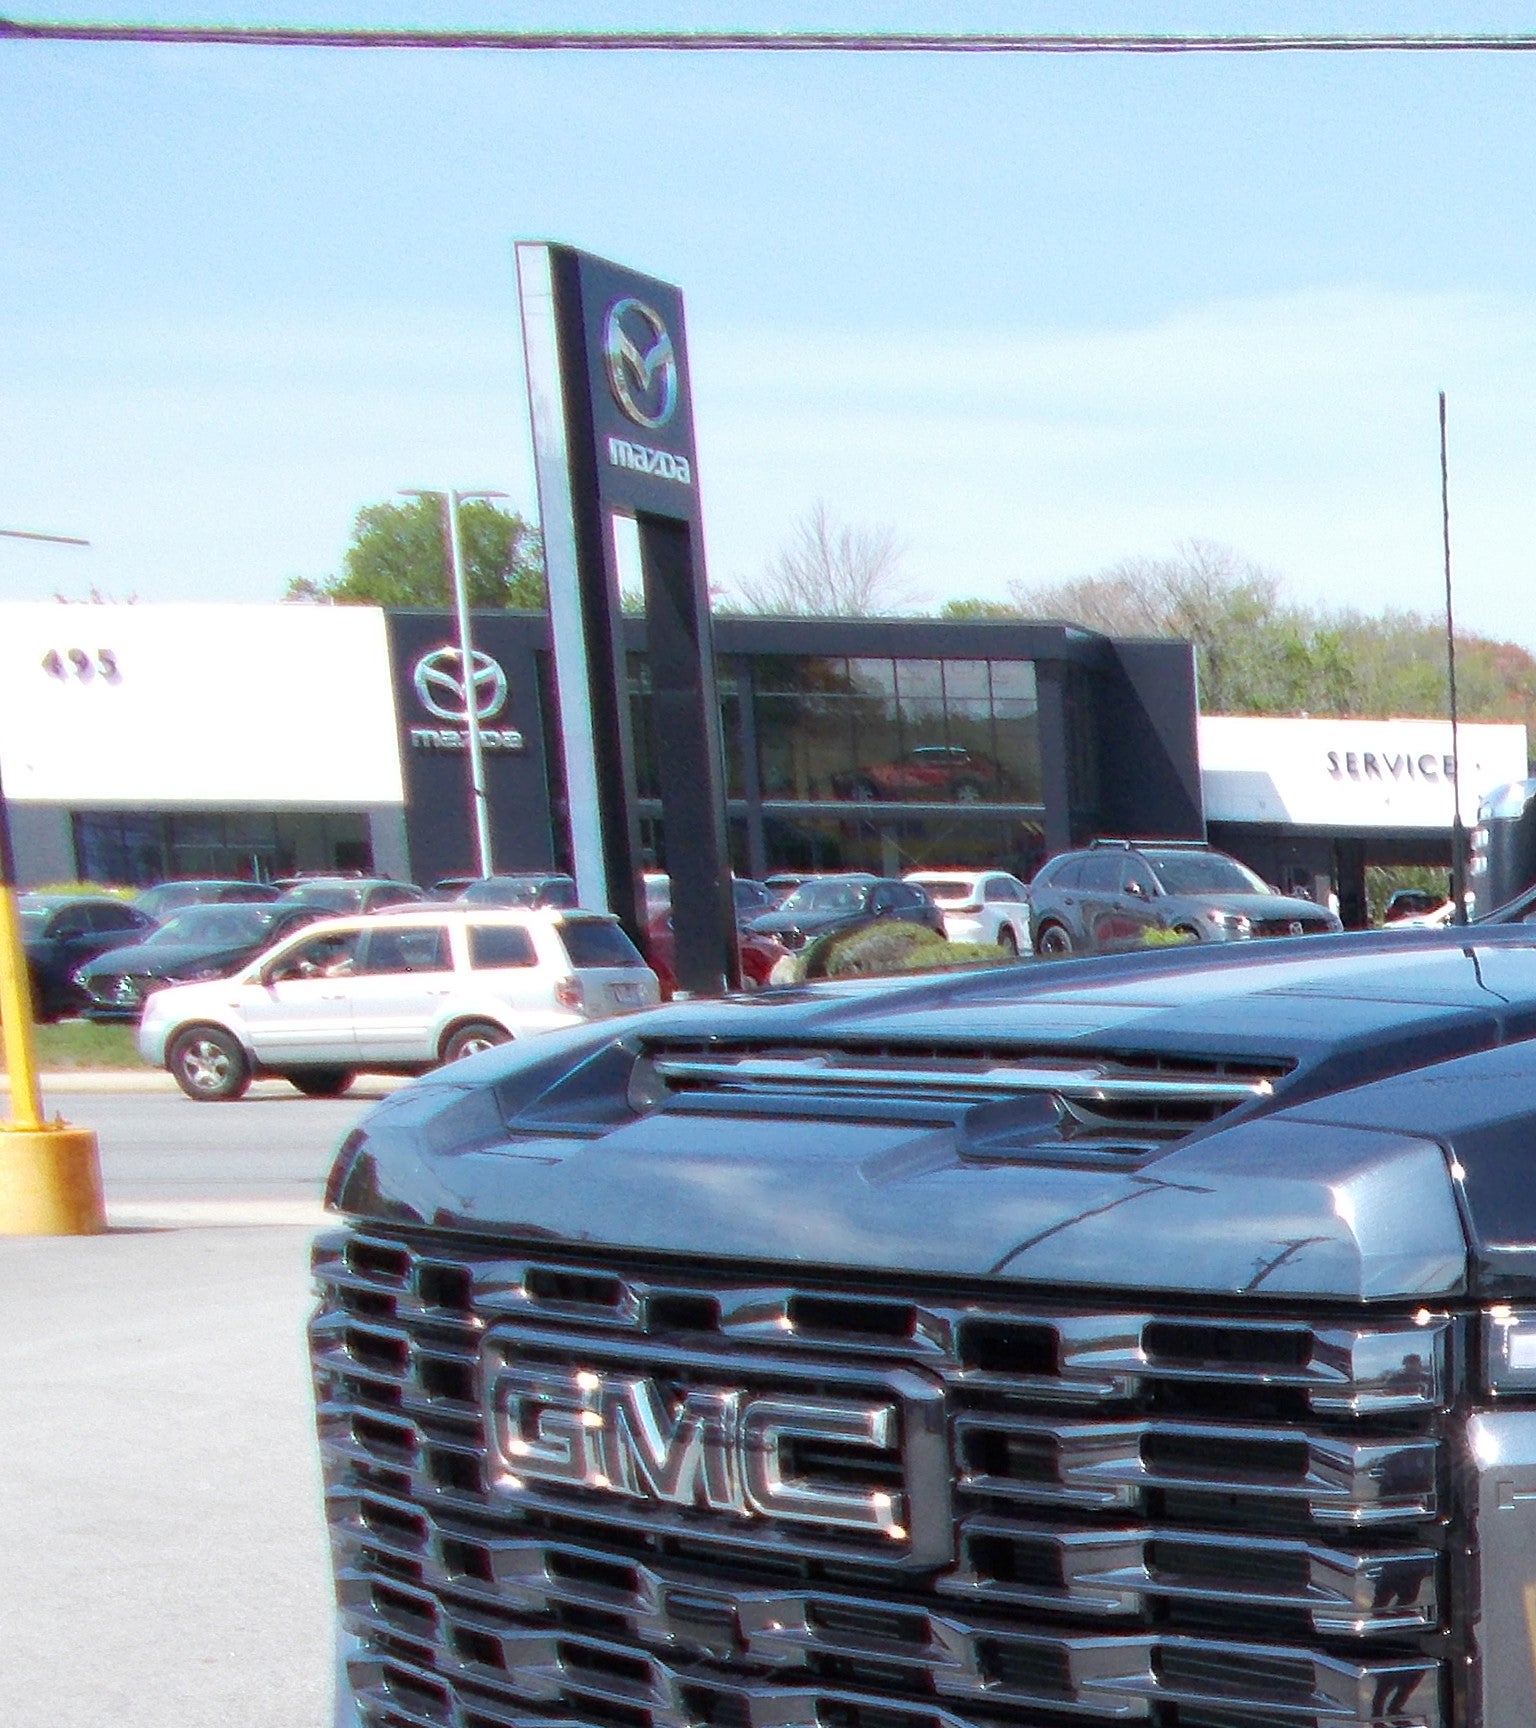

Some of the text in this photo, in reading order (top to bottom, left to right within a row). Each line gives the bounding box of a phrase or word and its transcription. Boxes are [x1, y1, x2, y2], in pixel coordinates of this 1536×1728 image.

[608, 437, 691, 485] mazda
[1326, 750, 1458, 780] SERVICE
[494, 1368, 906, 1540] GMC
